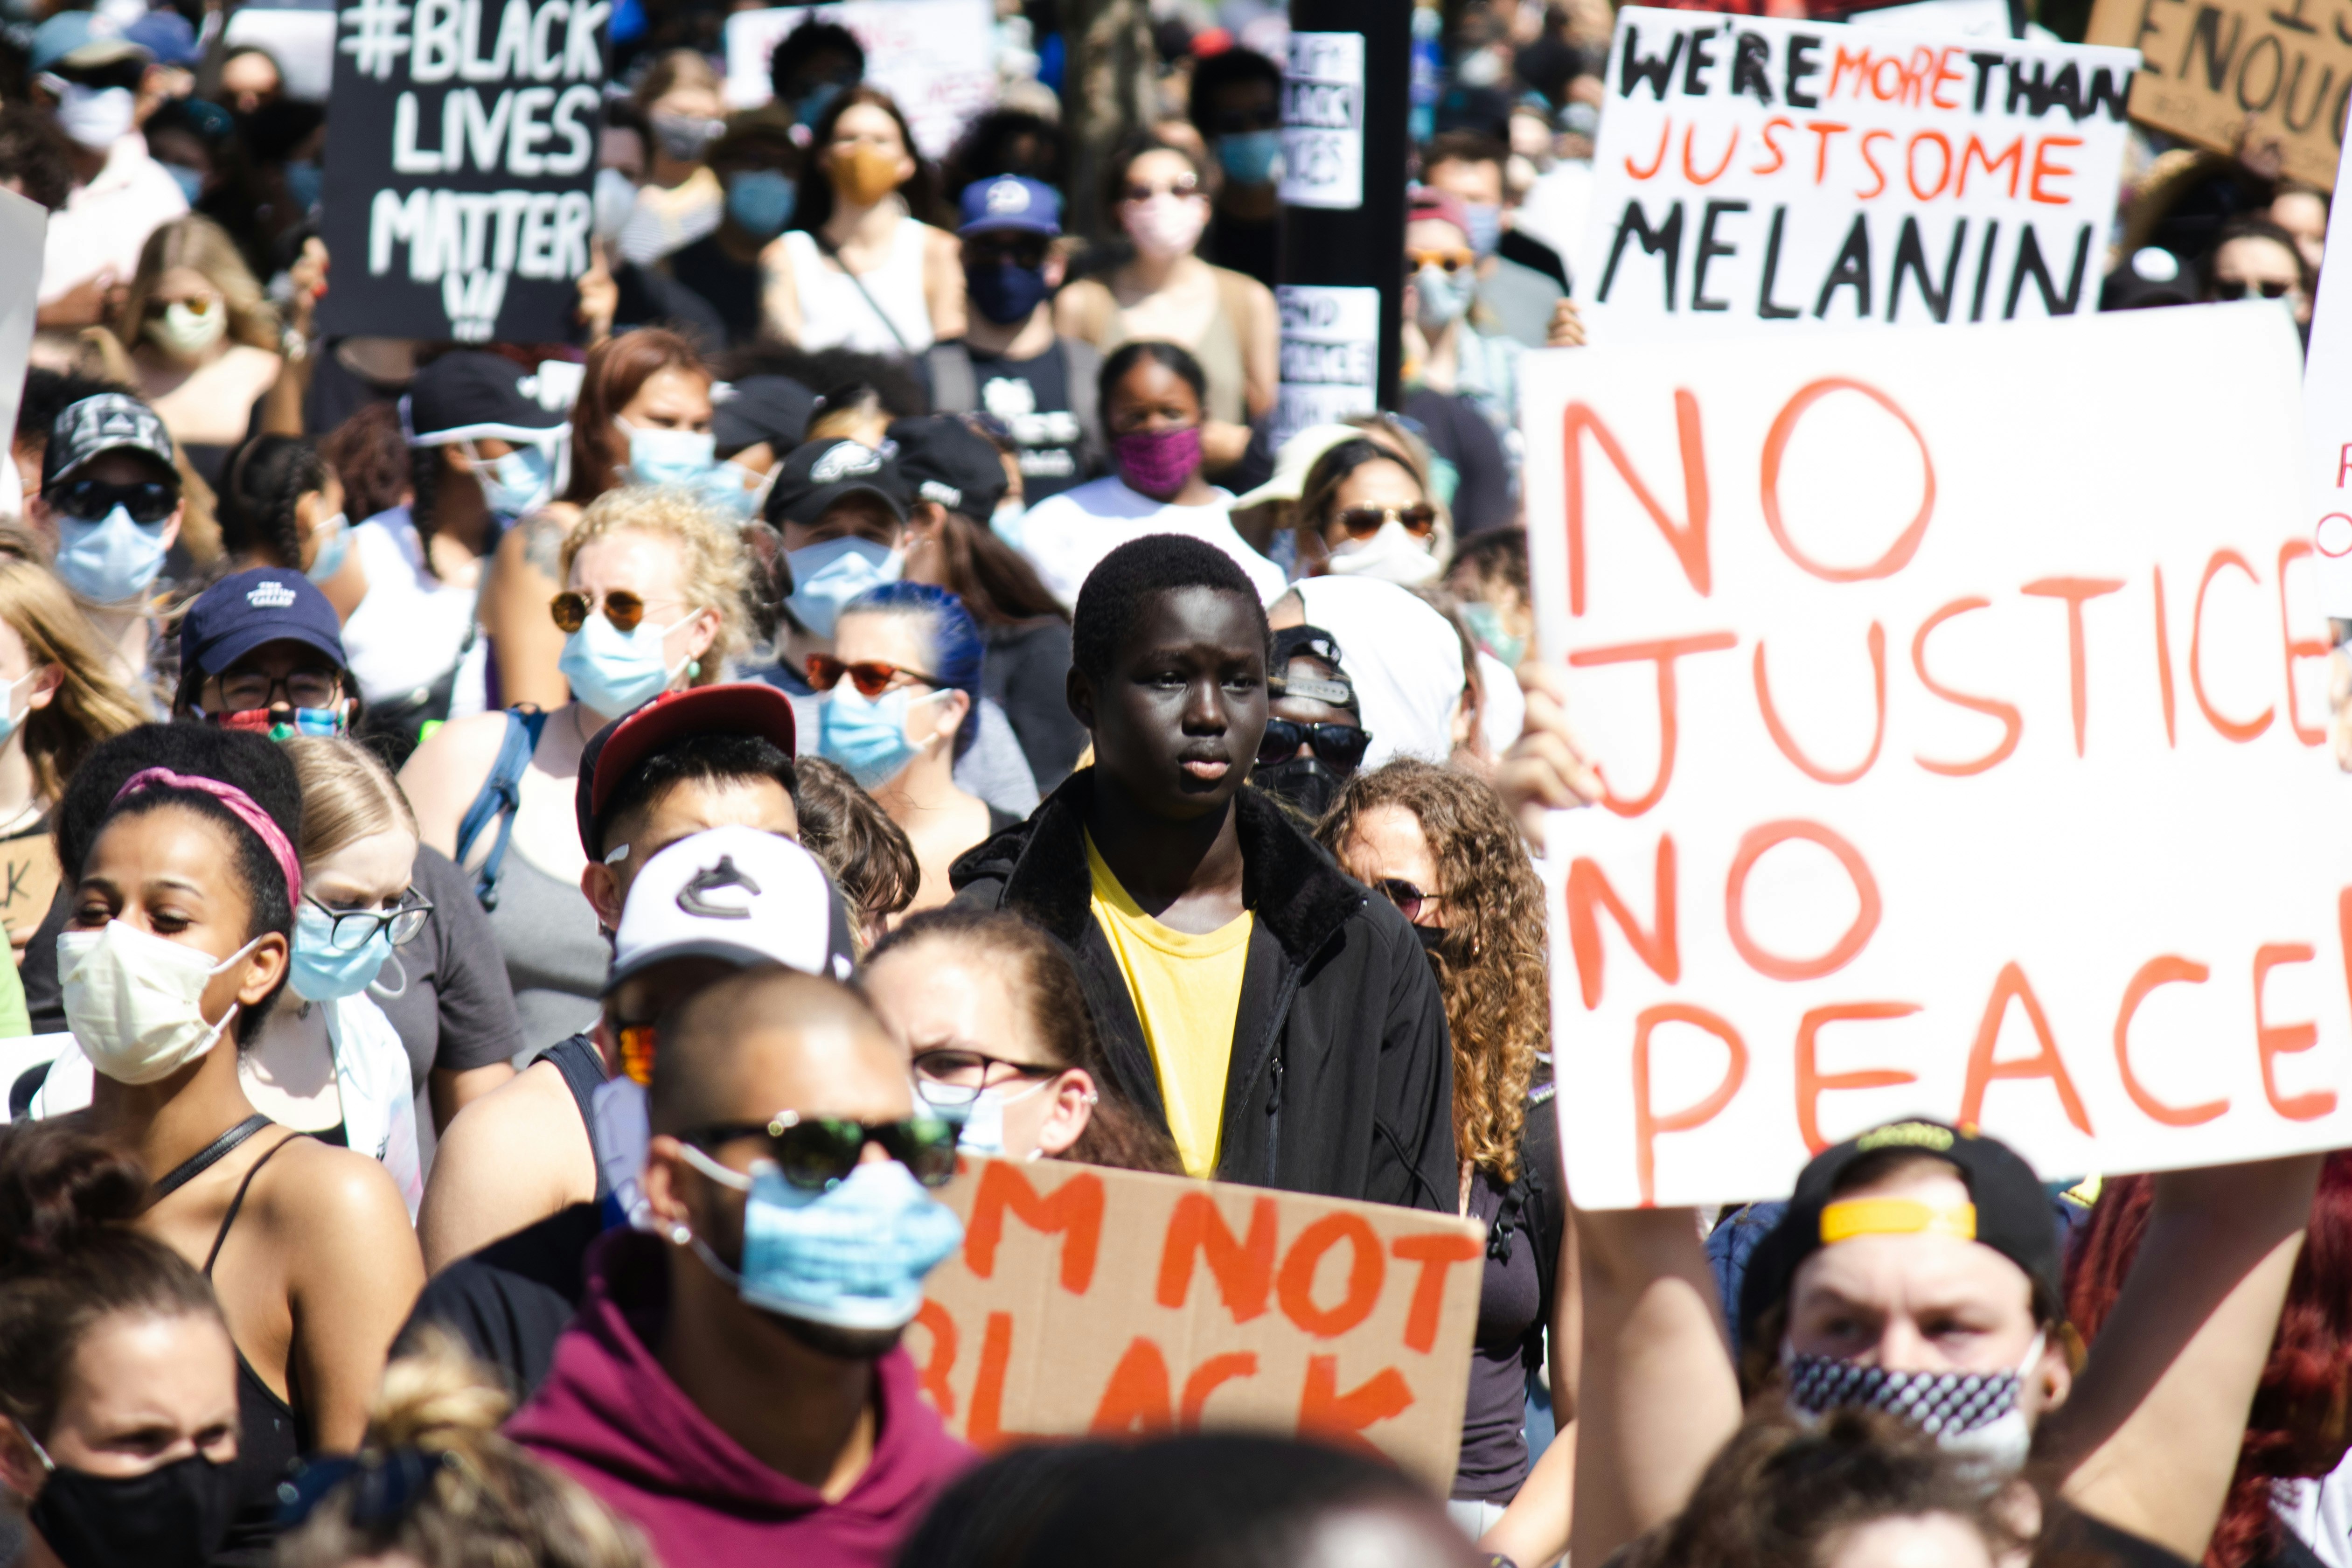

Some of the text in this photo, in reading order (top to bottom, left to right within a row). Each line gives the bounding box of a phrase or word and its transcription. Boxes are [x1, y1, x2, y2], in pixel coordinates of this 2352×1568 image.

[339, 0, 608, 83] #BLACK
[1620, 20, 1823, 109] WE'RE
[1828, 42, 1966, 110] MORE
[1969, 52, 2136, 124] THAN
[393, 86, 602, 175] LIVES
[1624, 116, 2086, 206] JUST SOME
[369, 188, 593, 281] MATTER
[1595, 196, 2094, 327] MELANIN
[1564, 376, 1936, 617] NO
[1567, 539, 2331, 817] JUSTICE
[1565, 816, 1883, 1011] NO
[1156, 1190, 1482, 1357] NOT
